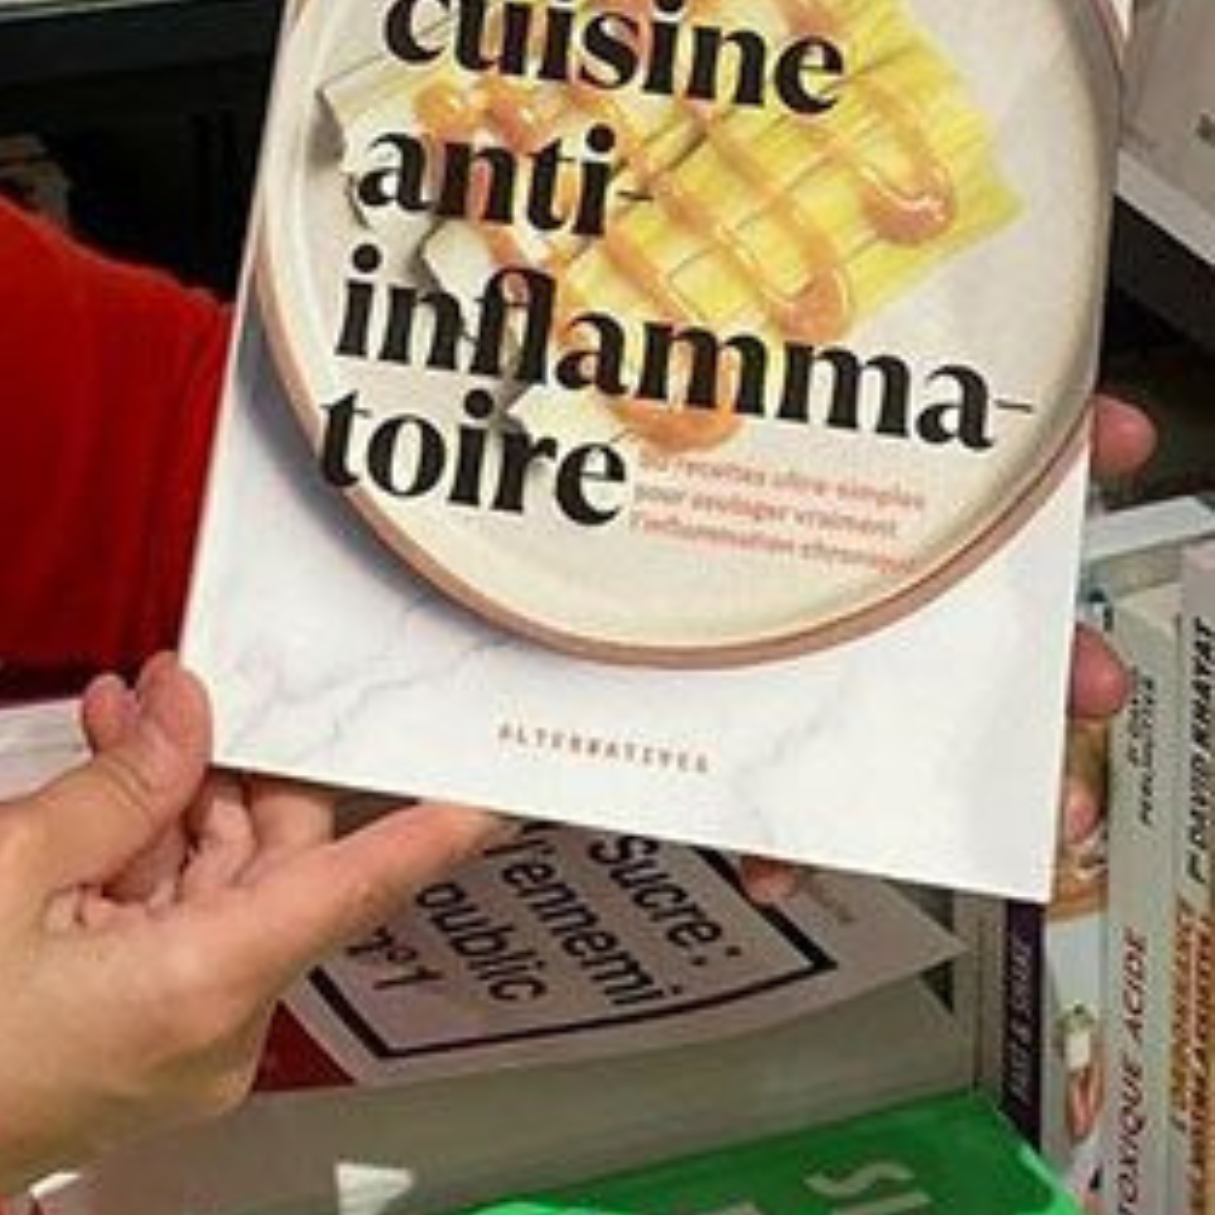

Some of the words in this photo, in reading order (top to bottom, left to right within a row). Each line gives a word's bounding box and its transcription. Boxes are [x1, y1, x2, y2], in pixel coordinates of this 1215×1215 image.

[358, 123, 653, 238] anti-
[335, 243, 1034, 451] inflamma-
[319, 388, 627, 526] toire
[1189, 616, 1213, 746] KHAYAT
[1122, 927, 1147, 1044] ACIDE
